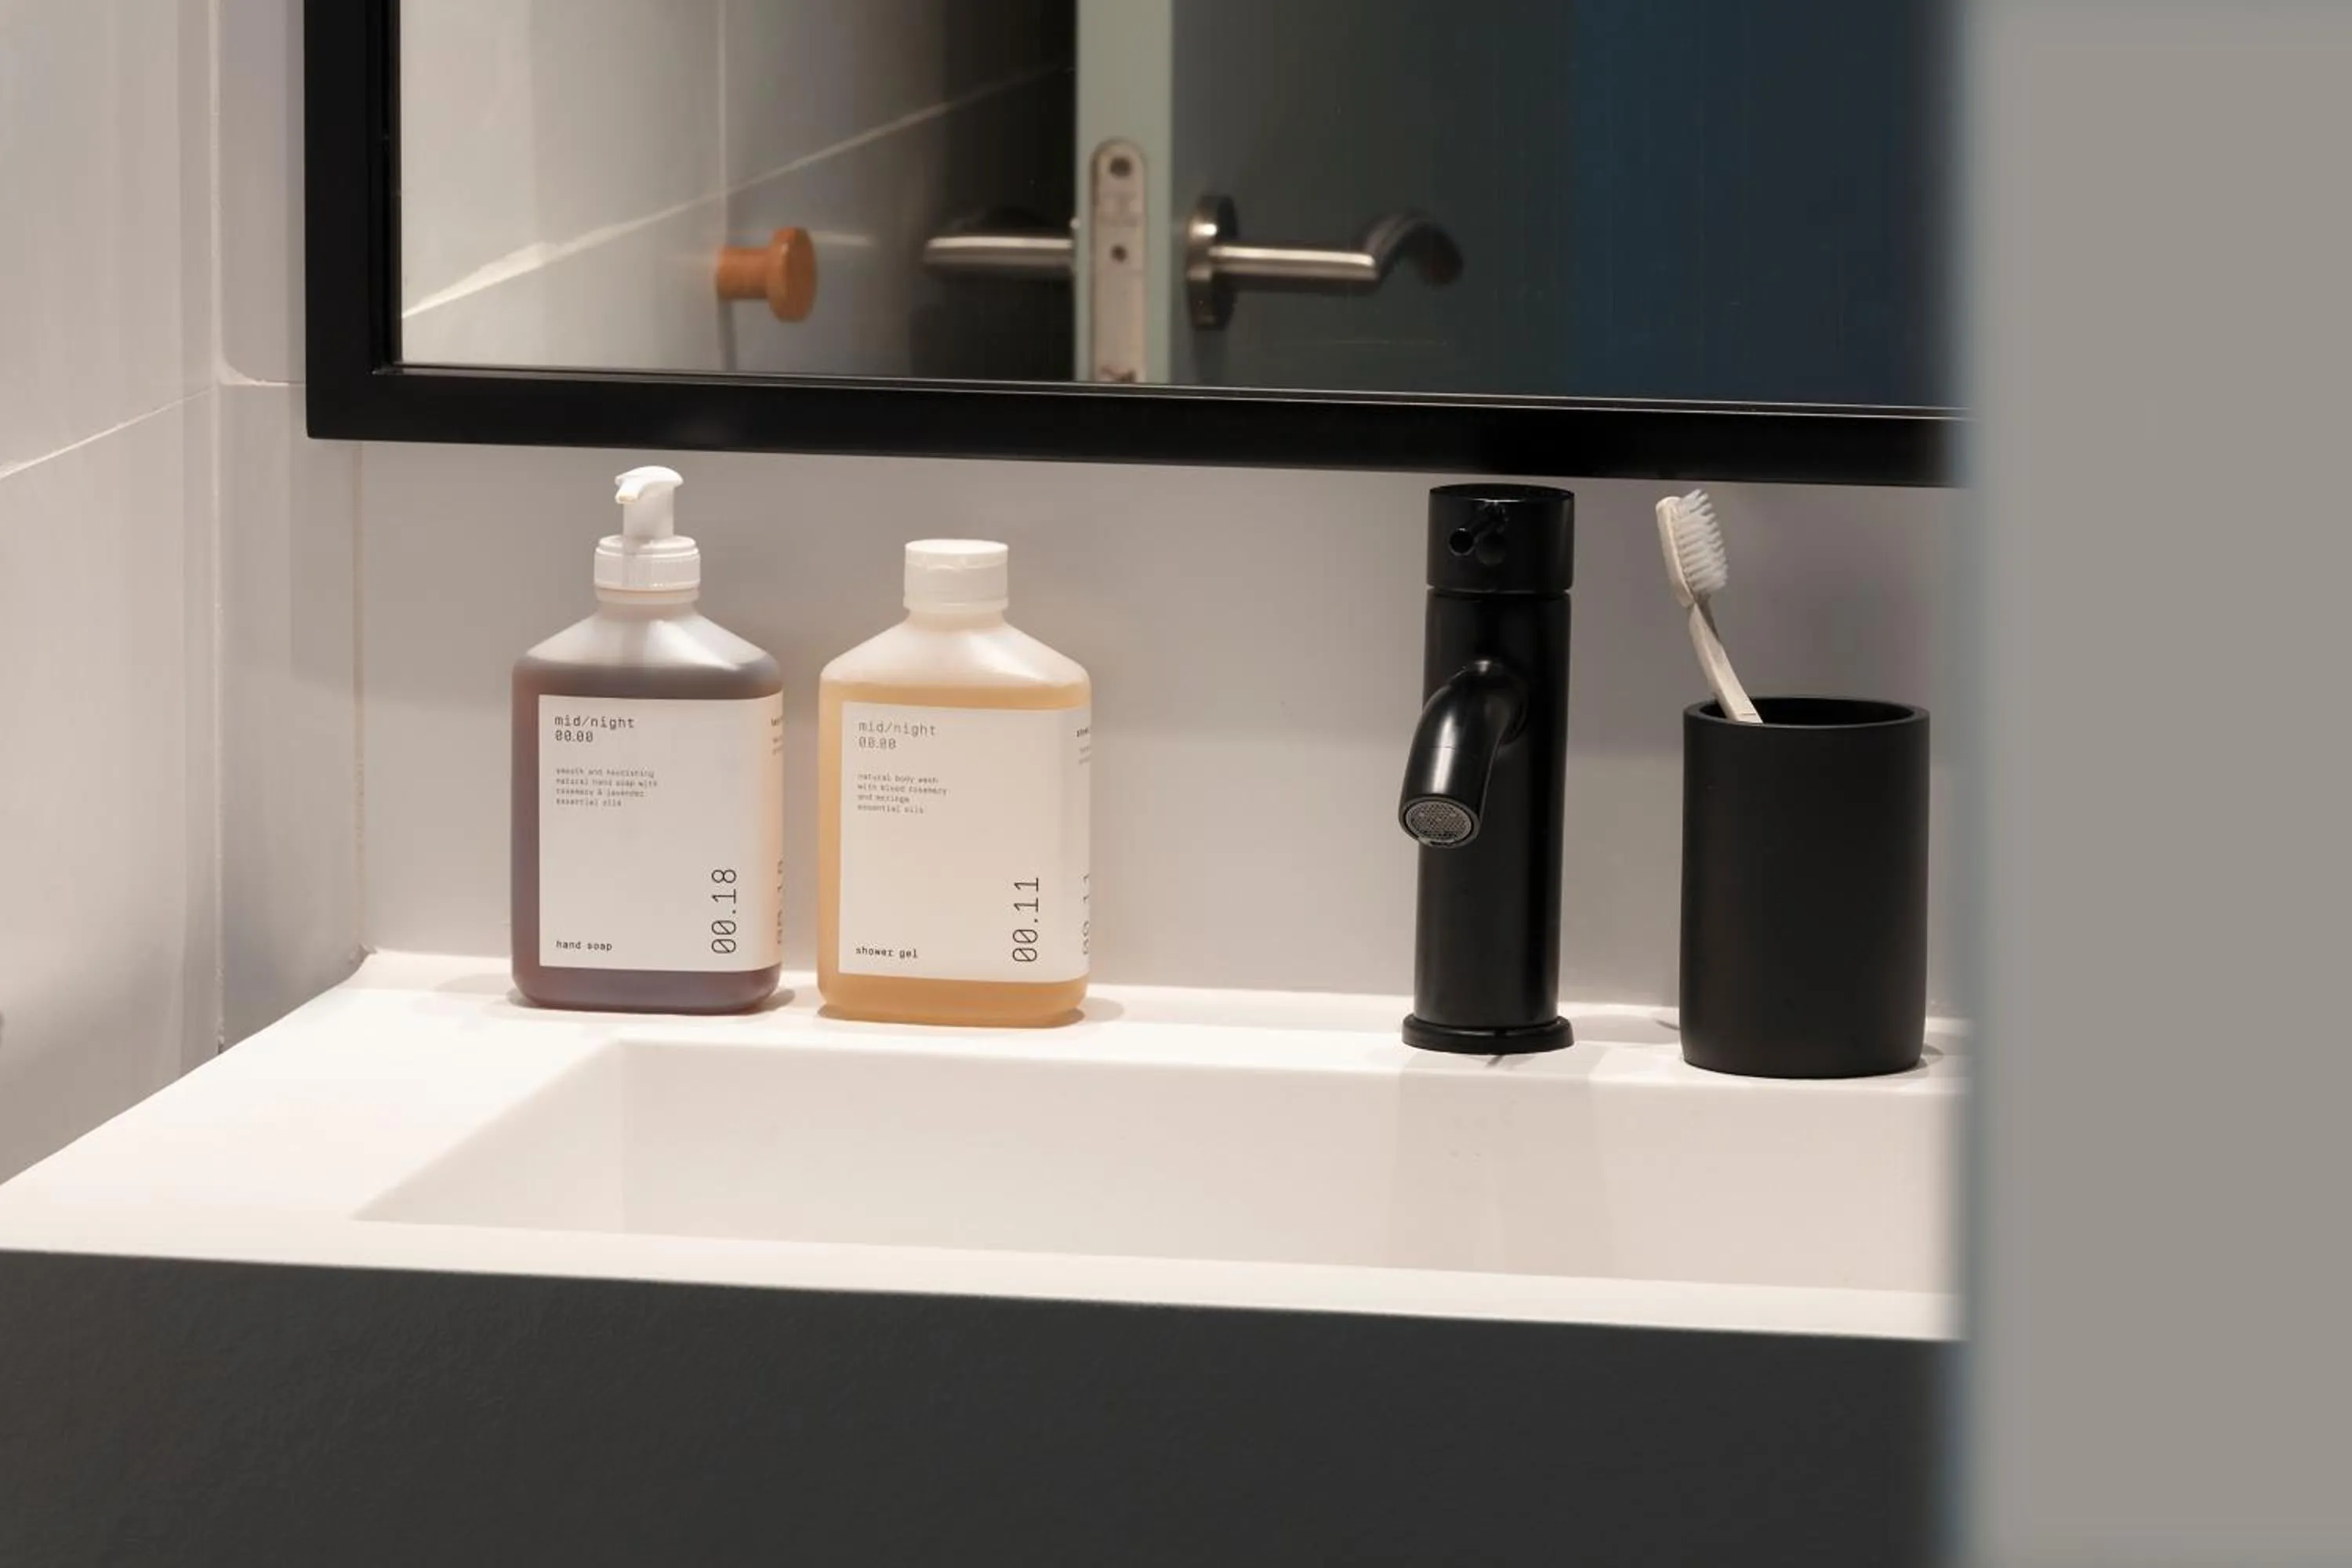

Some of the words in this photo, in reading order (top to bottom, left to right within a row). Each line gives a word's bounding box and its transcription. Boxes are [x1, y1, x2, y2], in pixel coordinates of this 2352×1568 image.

[554, 714, 635, 731] mid/night
[858, 720, 936, 738] mid/night
[711, 869, 738, 954] 00.18
[1012, 877, 1040, 962] 00.11
[556, 940, 582, 949] hand
[586, 942, 613, 952] soap
[855, 946, 895, 957] shower
[898, 948, 918, 959] gel
